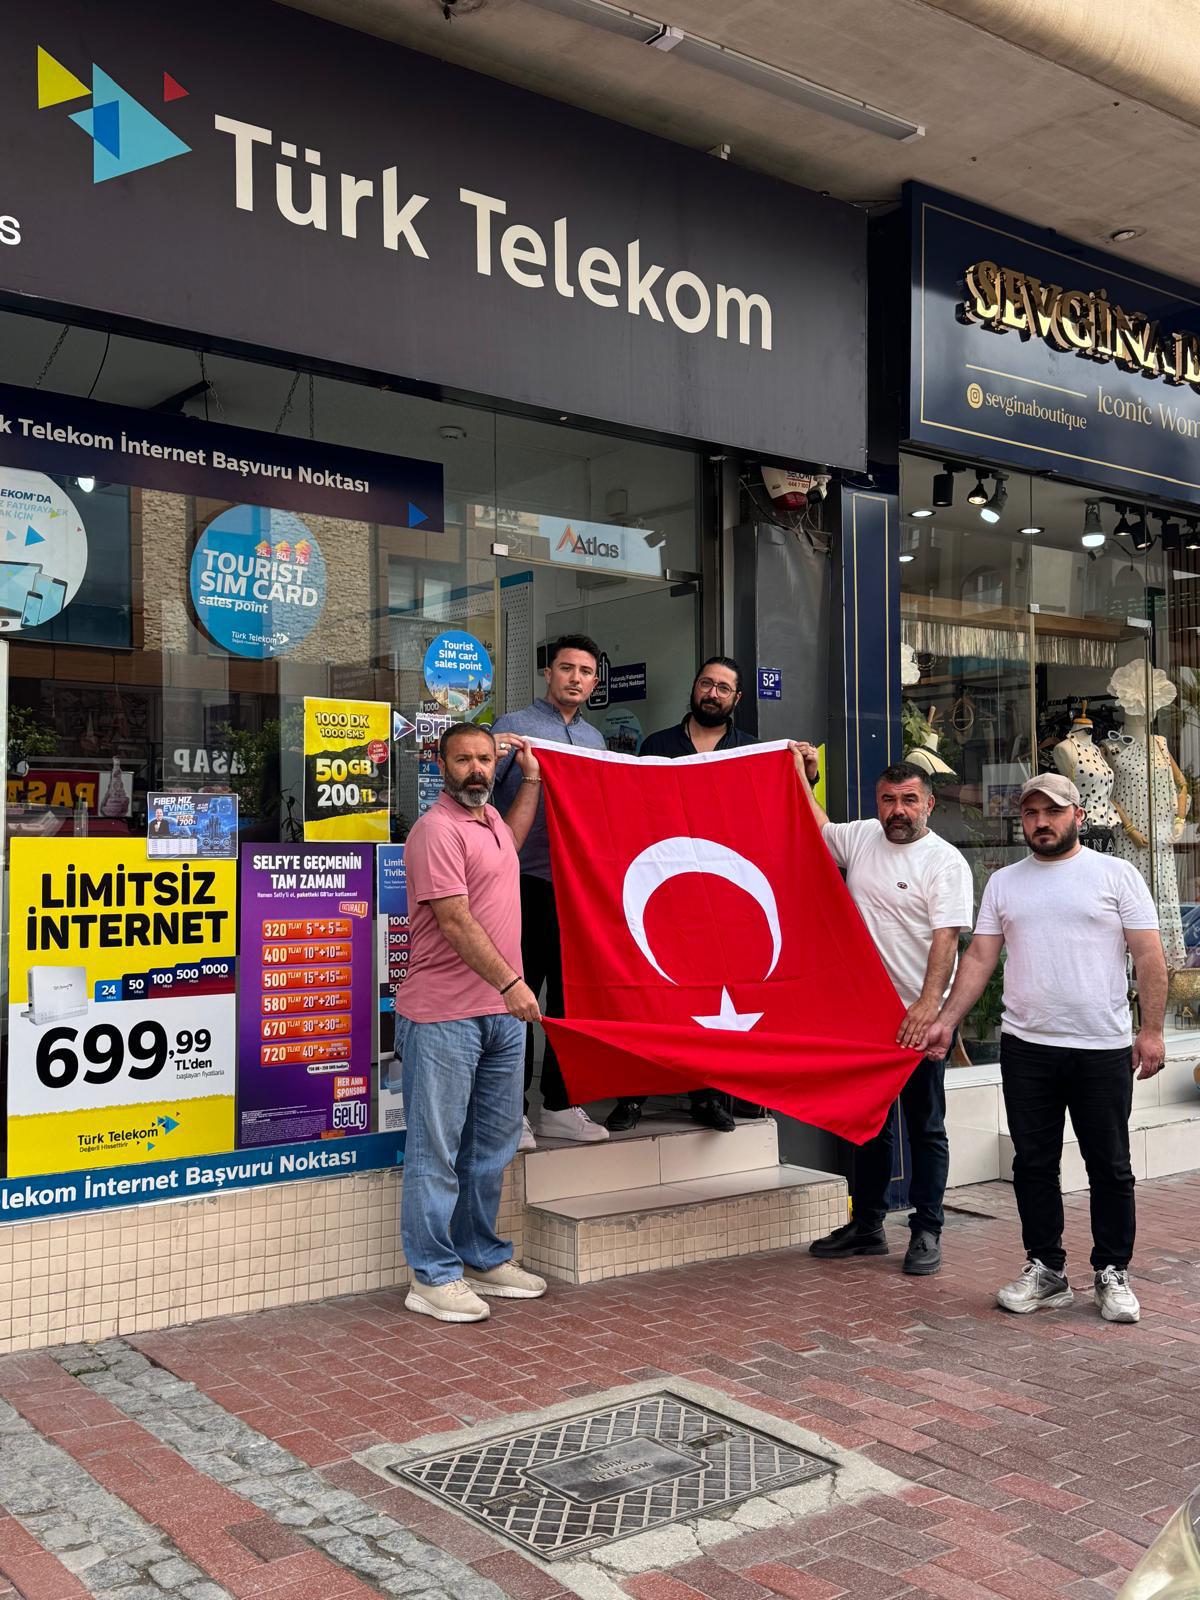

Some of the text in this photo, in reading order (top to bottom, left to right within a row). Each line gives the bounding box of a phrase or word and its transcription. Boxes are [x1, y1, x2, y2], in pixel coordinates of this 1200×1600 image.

[214, 114, 773, 350] Türk Telekom
[986, 391, 1087, 430] sevginaboutique
[1097, 385, 1153, 426] Iconic
[18, 418, 113, 450] Telekom
[121, 431, 205, 467] İnternet
[213, 451, 293, 480] Başvuru
[298, 467, 369, 493] Noktası
[571, 534, 619, 558] Atlas
[203, 549, 308, 585] TOURIST
[200, 571, 318, 607] SIM CARD
[199, 595, 268, 614] sales point
[443, 640, 474, 651] Tourist
[439, 650, 478, 660] SIM card
[434, 660, 482, 671] sales point
[763, 673, 774, 686] 52
[316, 712, 369, 728] 1000 DK
[320, 728, 365, 739] 1000 SMS
[423, 750, 432, 758] 50
[315, 759, 372, 782] 50 GB
[422, 764, 430, 772] 24
[317, 784, 376, 807] 200 TL
[253, 852, 362, 872] SELFY'E GEÇMENİN
[42, 863, 216, 909] LİMİTSİZ
[271, 874, 345, 889] TAM ZAMANI
[27, 906, 228, 950] İNTERNET
[265, 923, 287, 937] 320
[389, 934, 407, 943] 500
[264, 948, 287, 962] 400
[389, 952, 408, 961] 200
[176, 968, 199, 980] 500
[201, 963, 229, 975] 1000
[389, 969, 406, 978] 100
[129, 979, 144, 990] 50
[152, 973, 173, 985] 100
[264, 972, 287, 987] 500
[102, 985, 117, 996] 24
[264, 997, 287, 1012] 580
[264, 1021, 287, 1036] 670
[263, 1046, 287, 1062] 720
[337, 1077, 350, 1086] HER
[77, 1128, 158, 1146] Türk Telekom
[79, 1145, 100, 1153] Değerli
[84, 1174, 178, 1199] İnternet
[186, 1158, 273, 1189] Başvuru
[280, 1150, 357, 1173] Noktası
[592, 1461, 651, 1482] TELEKOM
